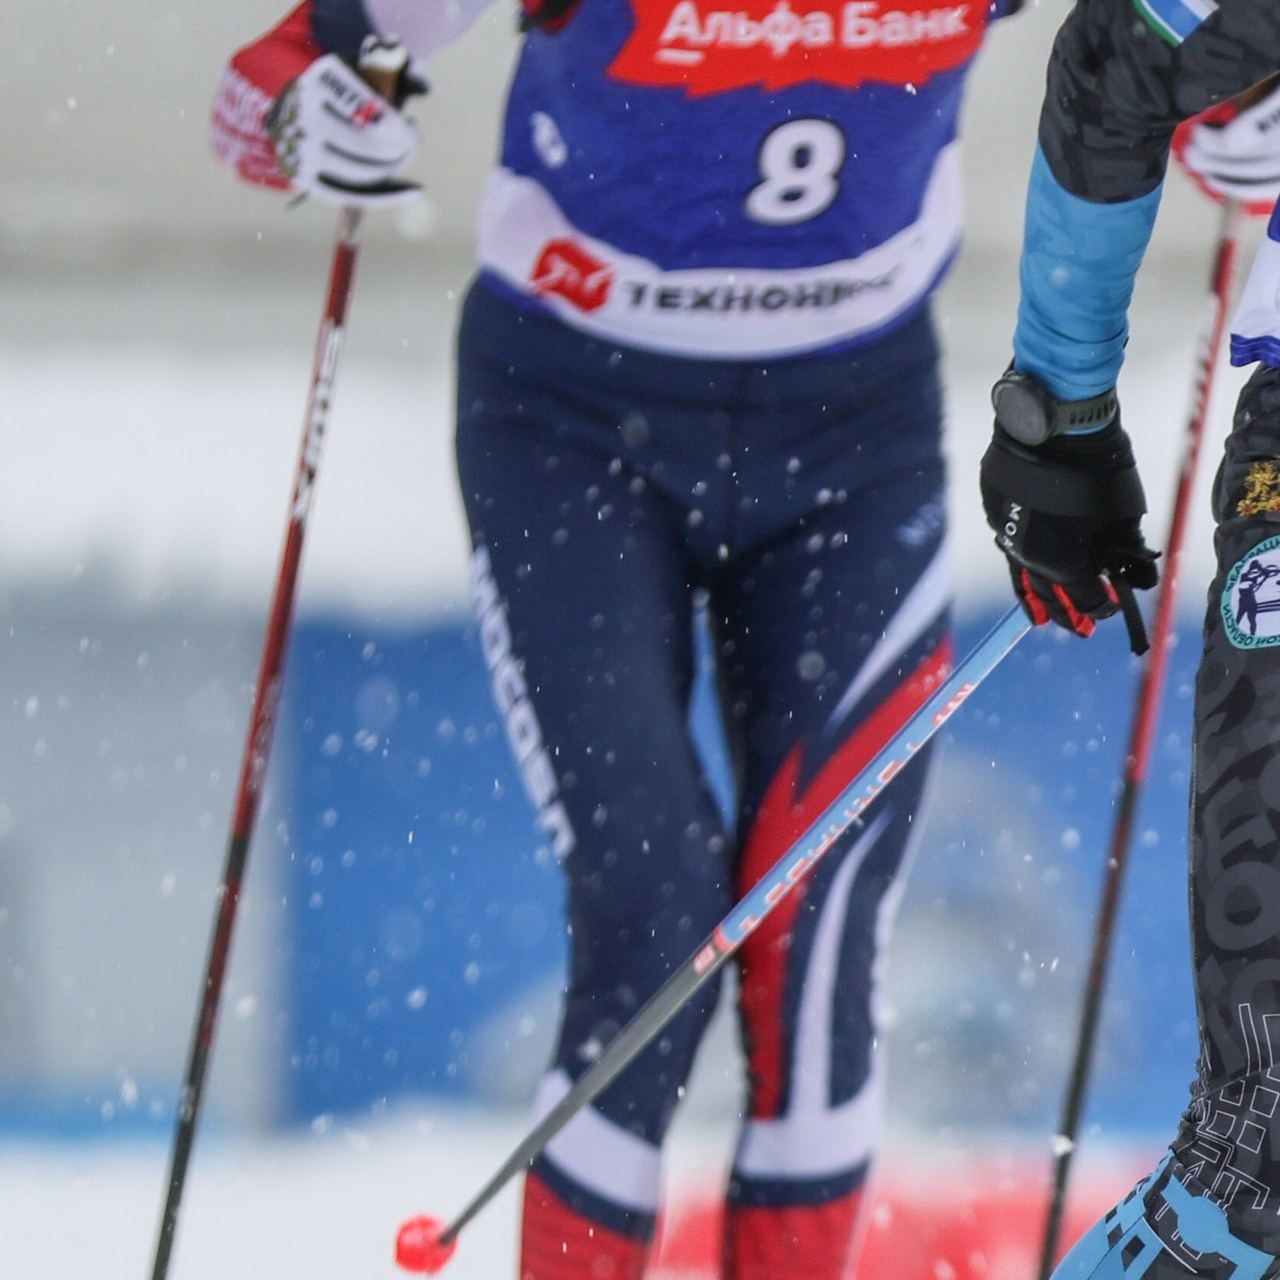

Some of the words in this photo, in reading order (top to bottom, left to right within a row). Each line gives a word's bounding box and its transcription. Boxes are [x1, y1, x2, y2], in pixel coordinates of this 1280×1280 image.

[659, 0, 835, 59] Альфа
[841, 0, 971, 50] Банк
[745, 116, 847, 226] 8
